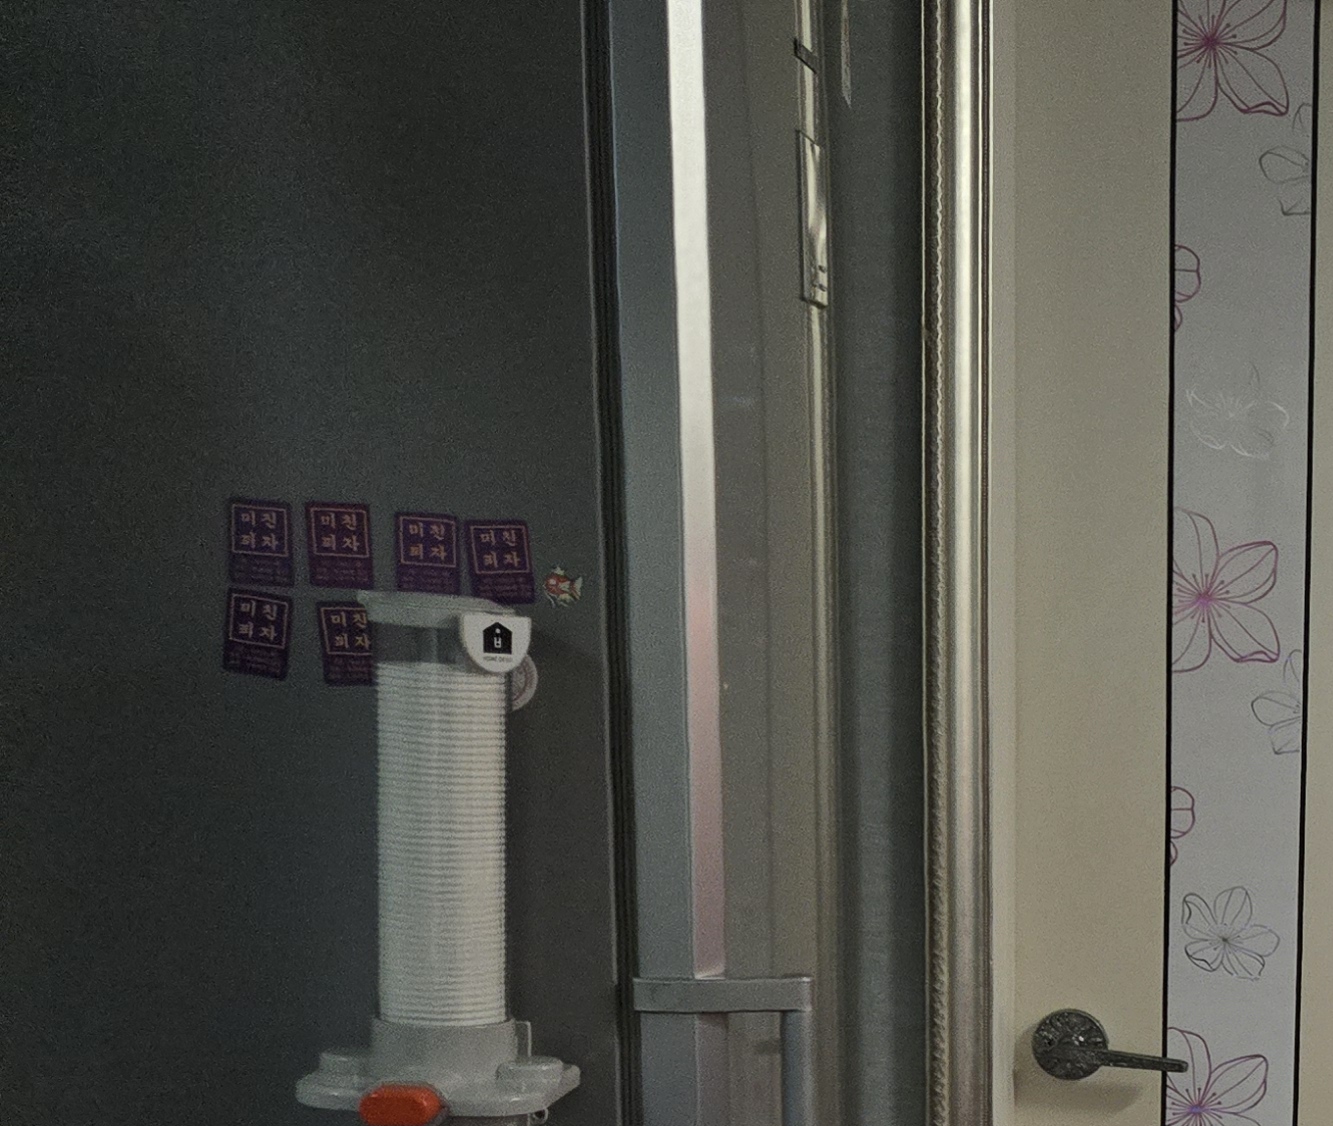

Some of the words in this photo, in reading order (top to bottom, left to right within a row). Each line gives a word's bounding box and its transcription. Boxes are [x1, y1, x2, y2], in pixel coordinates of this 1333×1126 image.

[240, 531, 278, 550] 피자
[321, 533, 360, 551] 피자
[410, 543, 447, 560] 피자
[483, 550, 521, 568] 피자
[238, 621, 277, 641] 피자
[334, 633, 372, 650] 피자
